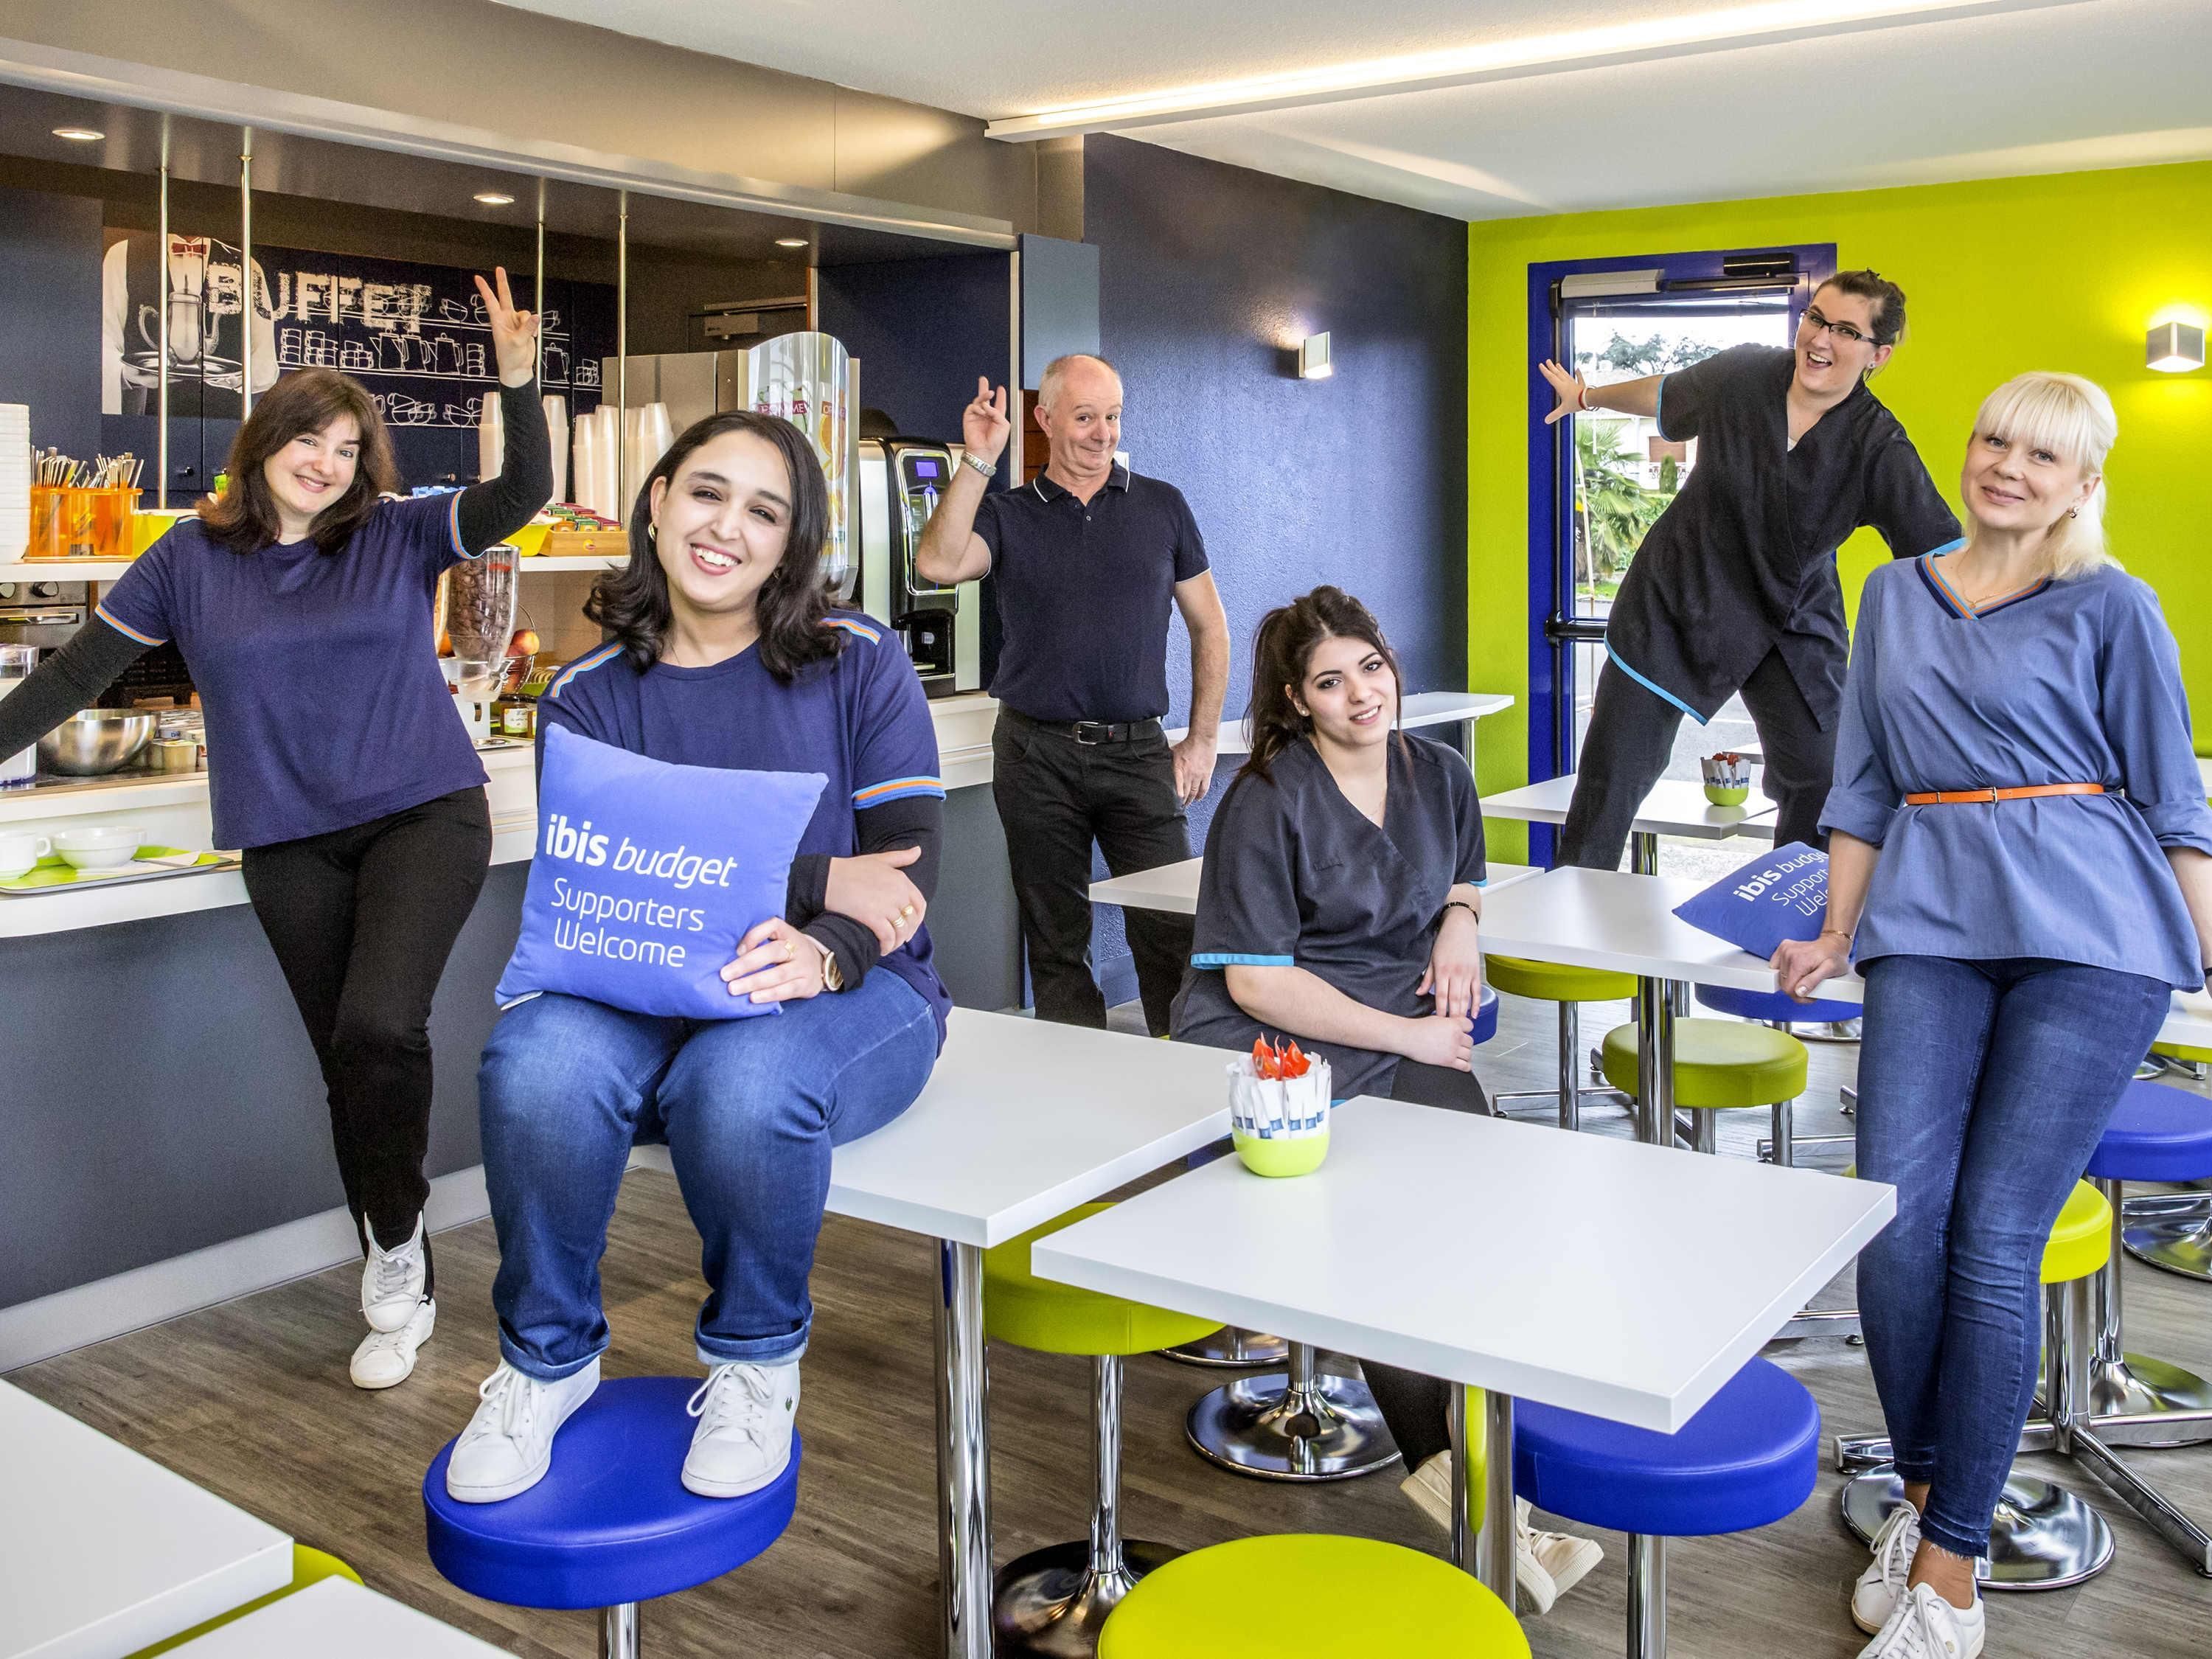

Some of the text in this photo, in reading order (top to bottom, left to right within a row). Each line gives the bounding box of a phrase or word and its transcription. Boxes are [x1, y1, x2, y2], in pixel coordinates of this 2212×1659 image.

[207, 260, 432, 334] BUFFET
[545, 813, 738, 890] ibis budget
[551, 877, 706, 932] Supporters
[1733, 869, 1782, 902] ibis
[554, 917, 686, 968] Welcome
